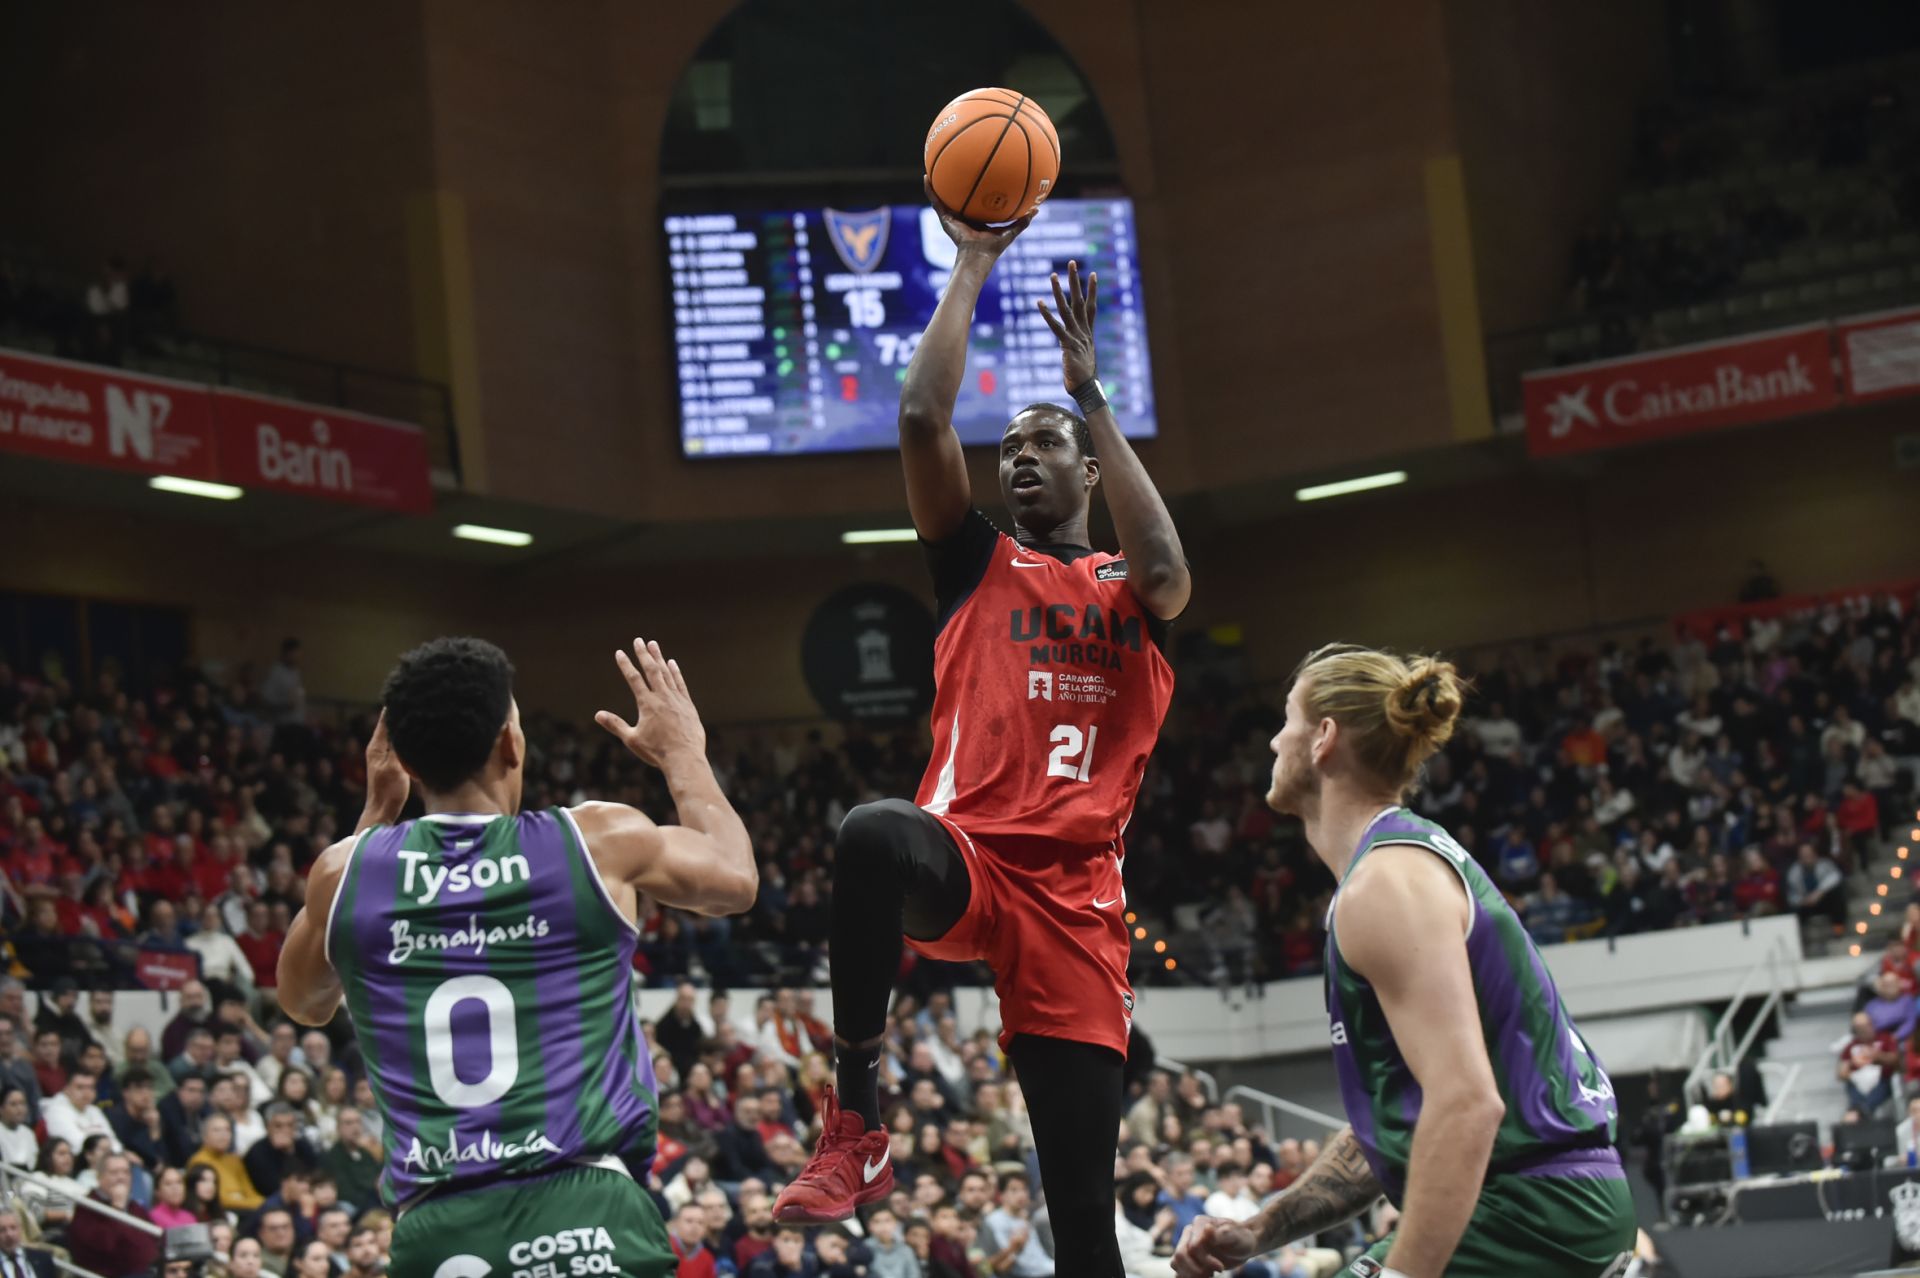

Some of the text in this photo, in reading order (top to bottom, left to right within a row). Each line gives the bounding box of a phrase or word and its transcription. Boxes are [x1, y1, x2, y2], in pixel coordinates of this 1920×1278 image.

[843, 289, 885, 328] 15
[1603, 352, 1815, 426] CaixaBank
[18, 413, 94, 445] marca
[1010, 604, 1141, 653] UCAM
[1030, 644, 1122, 672] MURCIA
[1058, 683, 1070, 691] DE
[1071, 683, 1081, 692] LA
[1082, 684, 1104, 693] CRUZ
[1058, 691, 1076, 701] AÑO
[1047, 724, 1098, 783] 21
[397, 850, 531, 905] Tyson
[424, 974, 519, 1108] 0
[508, 1226, 616, 1266] COSTA
[569, 1253, 621, 1276] SOL
